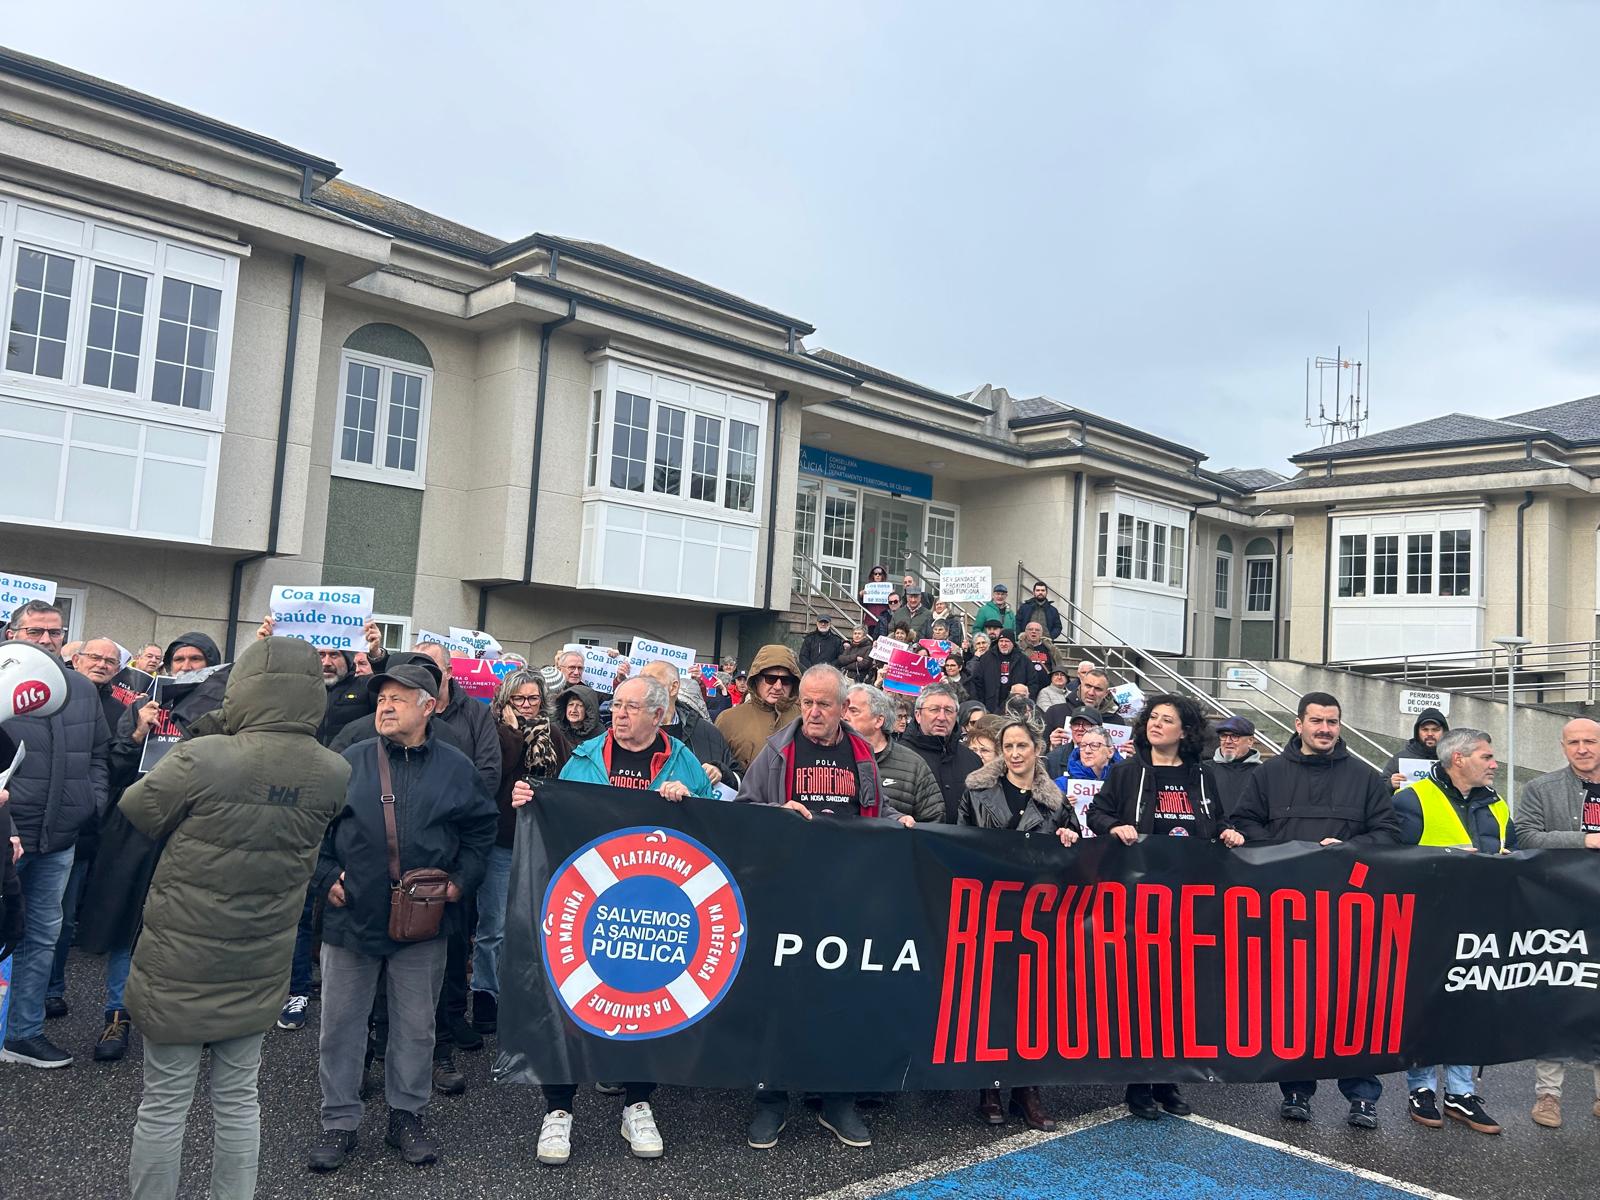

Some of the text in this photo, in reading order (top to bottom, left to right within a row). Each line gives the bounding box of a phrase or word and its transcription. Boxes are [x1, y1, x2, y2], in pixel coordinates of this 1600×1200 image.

[800, 462, 823, 473] ALICIA
[13, 579, 47, 592] nosa
[281, 588, 361, 604] Coa nosa
[275, 609, 364, 627] saúde non
[310, 634, 351, 649] xoga
[637, 640, 688, 660] Coa nosa
[586, 651, 622, 666] Coa nos
[584, 666, 609, 678] aúde
[595, 683, 613, 693] xog
[1409, 692, 1440, 700] PERMISOS
[1416, 700, 1441, 708] CORTAS
[619, 769, 642, 777] POLA
[796, 766, 856, 797] RESURRECCIÓN
[612, 850, 692, 877] PLATAFORMA
[597, 905, 691, 928] SALVEMOS
[559, 890, 585, 964] DA MARIÑA
[593, 923, 689, 944] A SANIDADE
[591, 936, 686, 964] PÚBLICA
[697, 904, 725, 981] NA DEFENSA
[773, 933, 921, 971] POLA
[1455, 928, 1589, 960] DA NOSA
[932, 861, 1416, 1065] RESURRECCIÓN
[1444, 961, 1600, 992] SANIDADE
[587, 994, 672, 1019] DA SANIDADE
